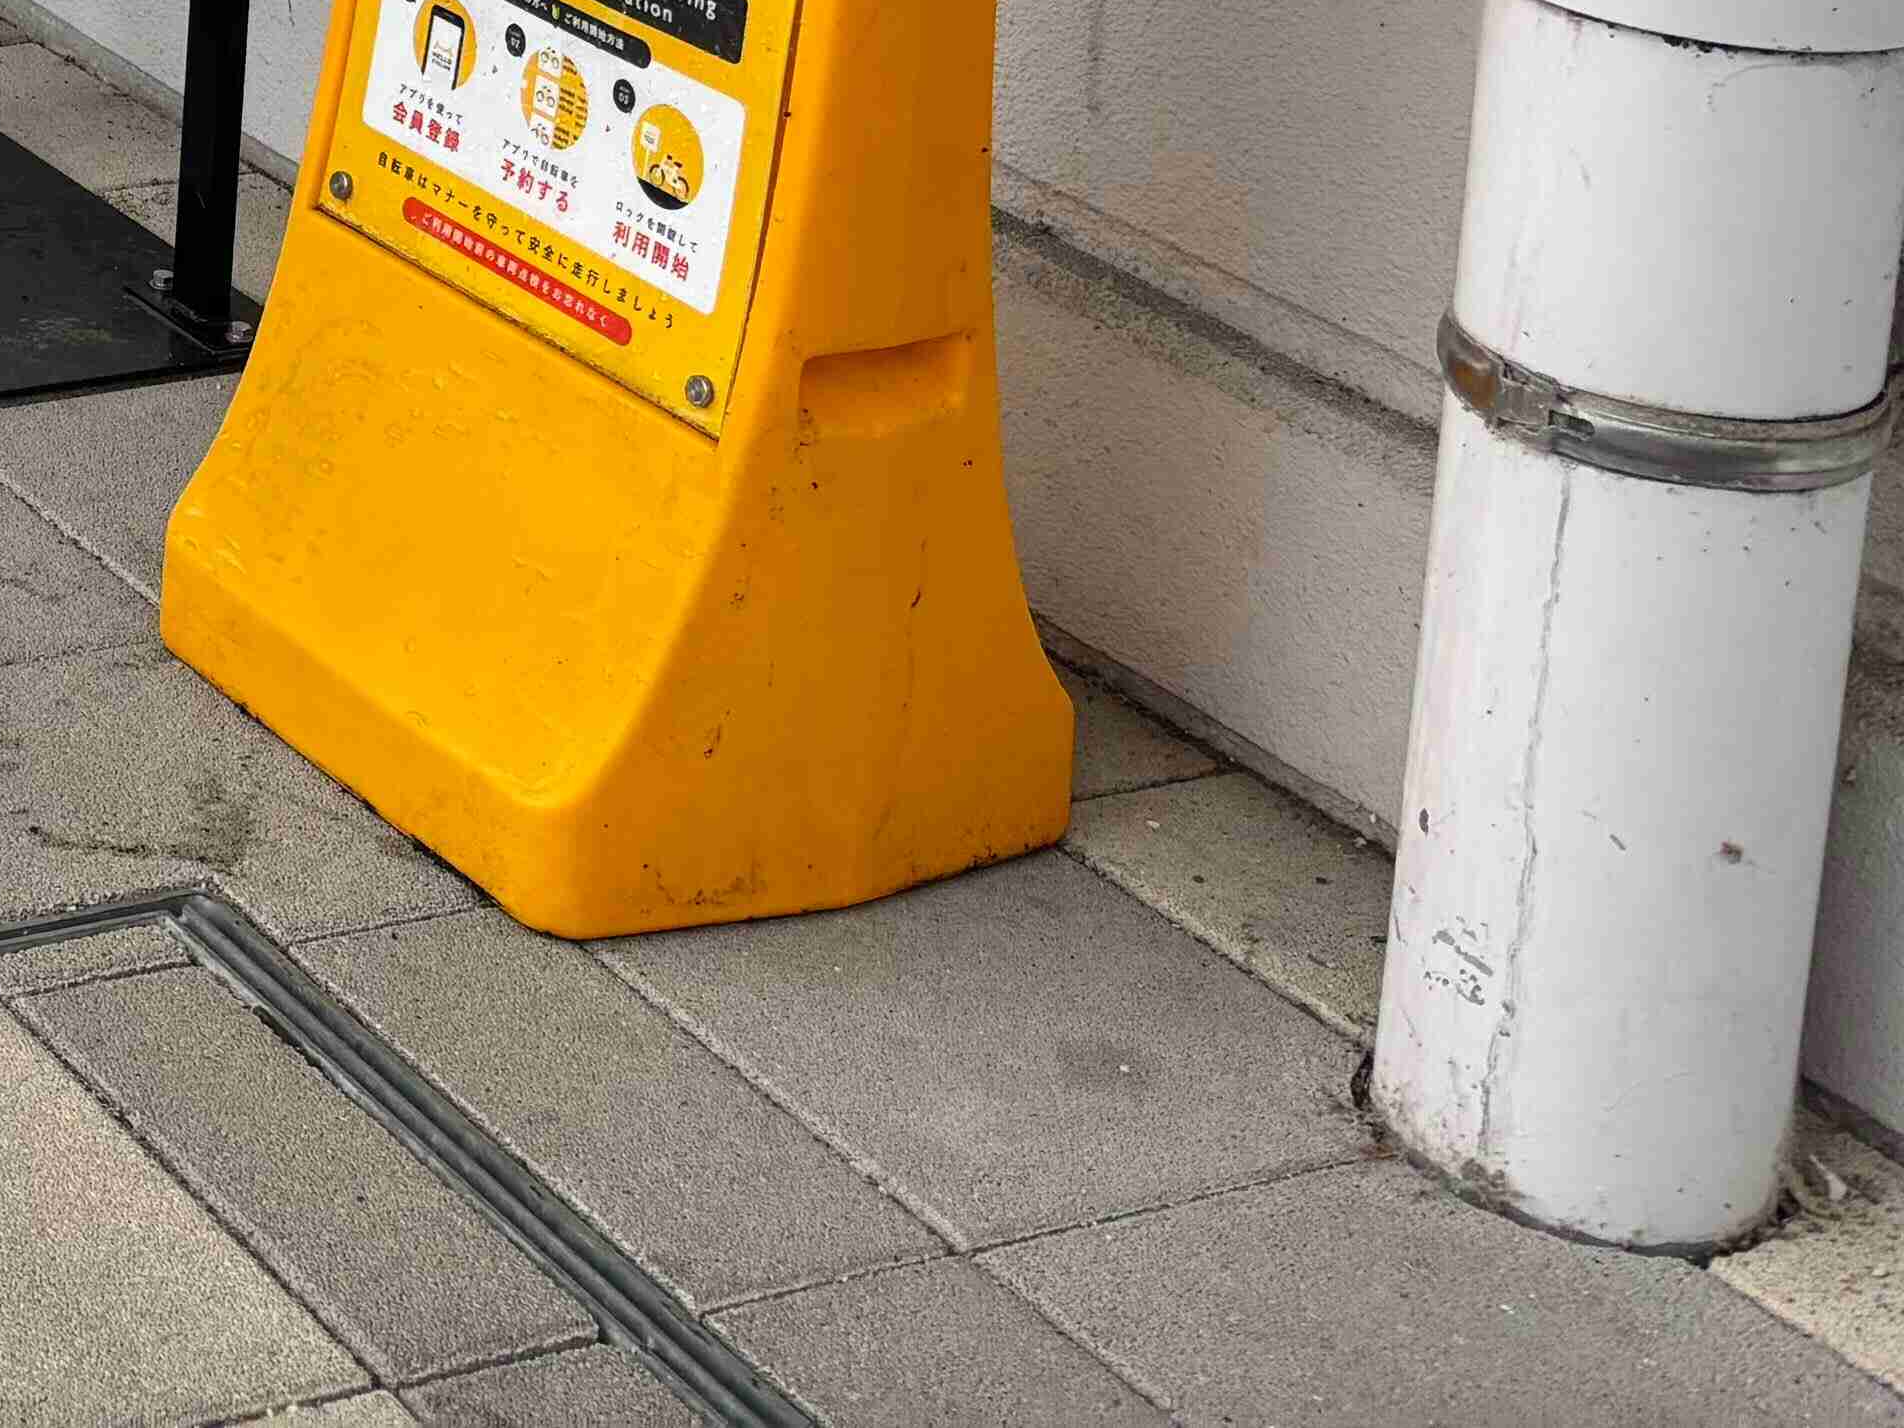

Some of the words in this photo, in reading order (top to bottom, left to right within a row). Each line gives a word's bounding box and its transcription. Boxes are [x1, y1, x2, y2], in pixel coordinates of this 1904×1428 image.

[392, 101, 461, 152] 会員登録
[500, 157, 569, 213] 予約する
[377, 151, 673, 329] 自転車はマナーを守って安全に走行しましょう
[612, 220, 689, 282] 利用開始
